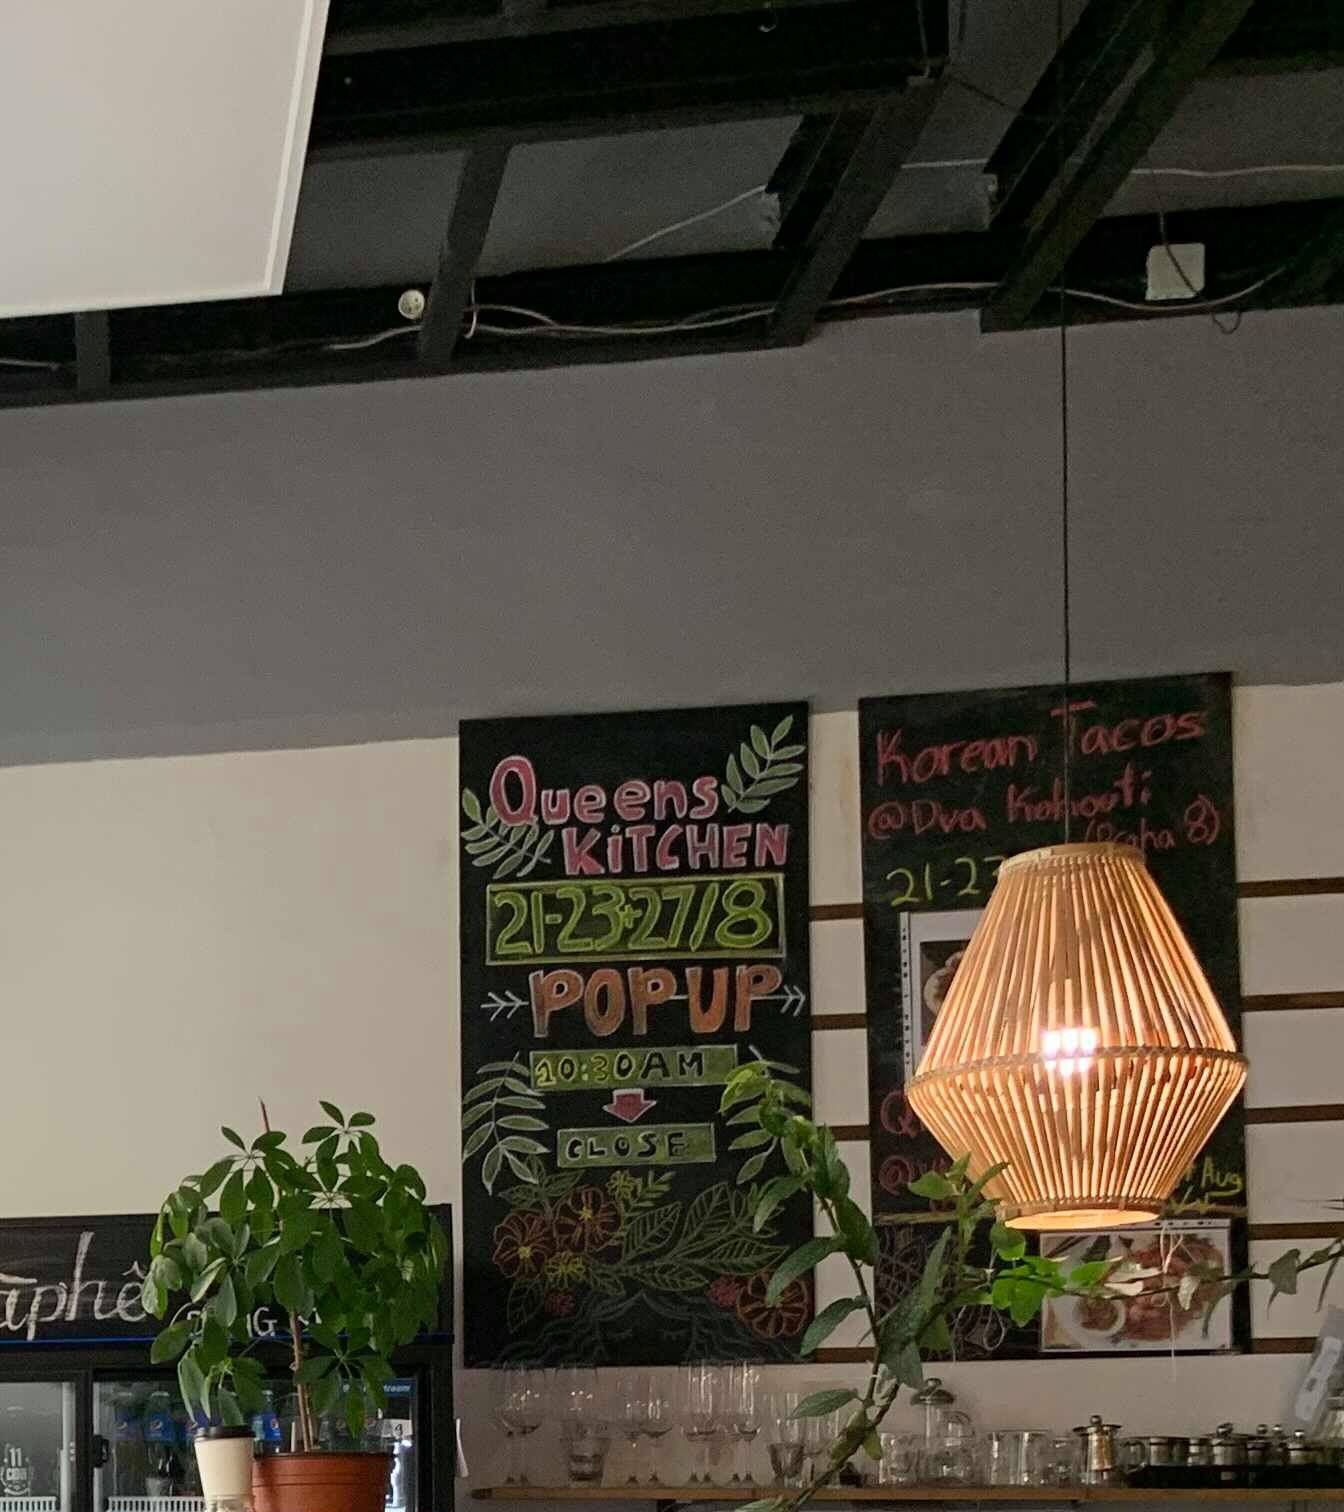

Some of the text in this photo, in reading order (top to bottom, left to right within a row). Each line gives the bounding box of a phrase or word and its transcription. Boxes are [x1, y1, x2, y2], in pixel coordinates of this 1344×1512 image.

[876, 700, 1206, 785] Korean Tacos
[489, 754, 719, 827] Queens
[566, 1130, 688, 1160] CLOSE
